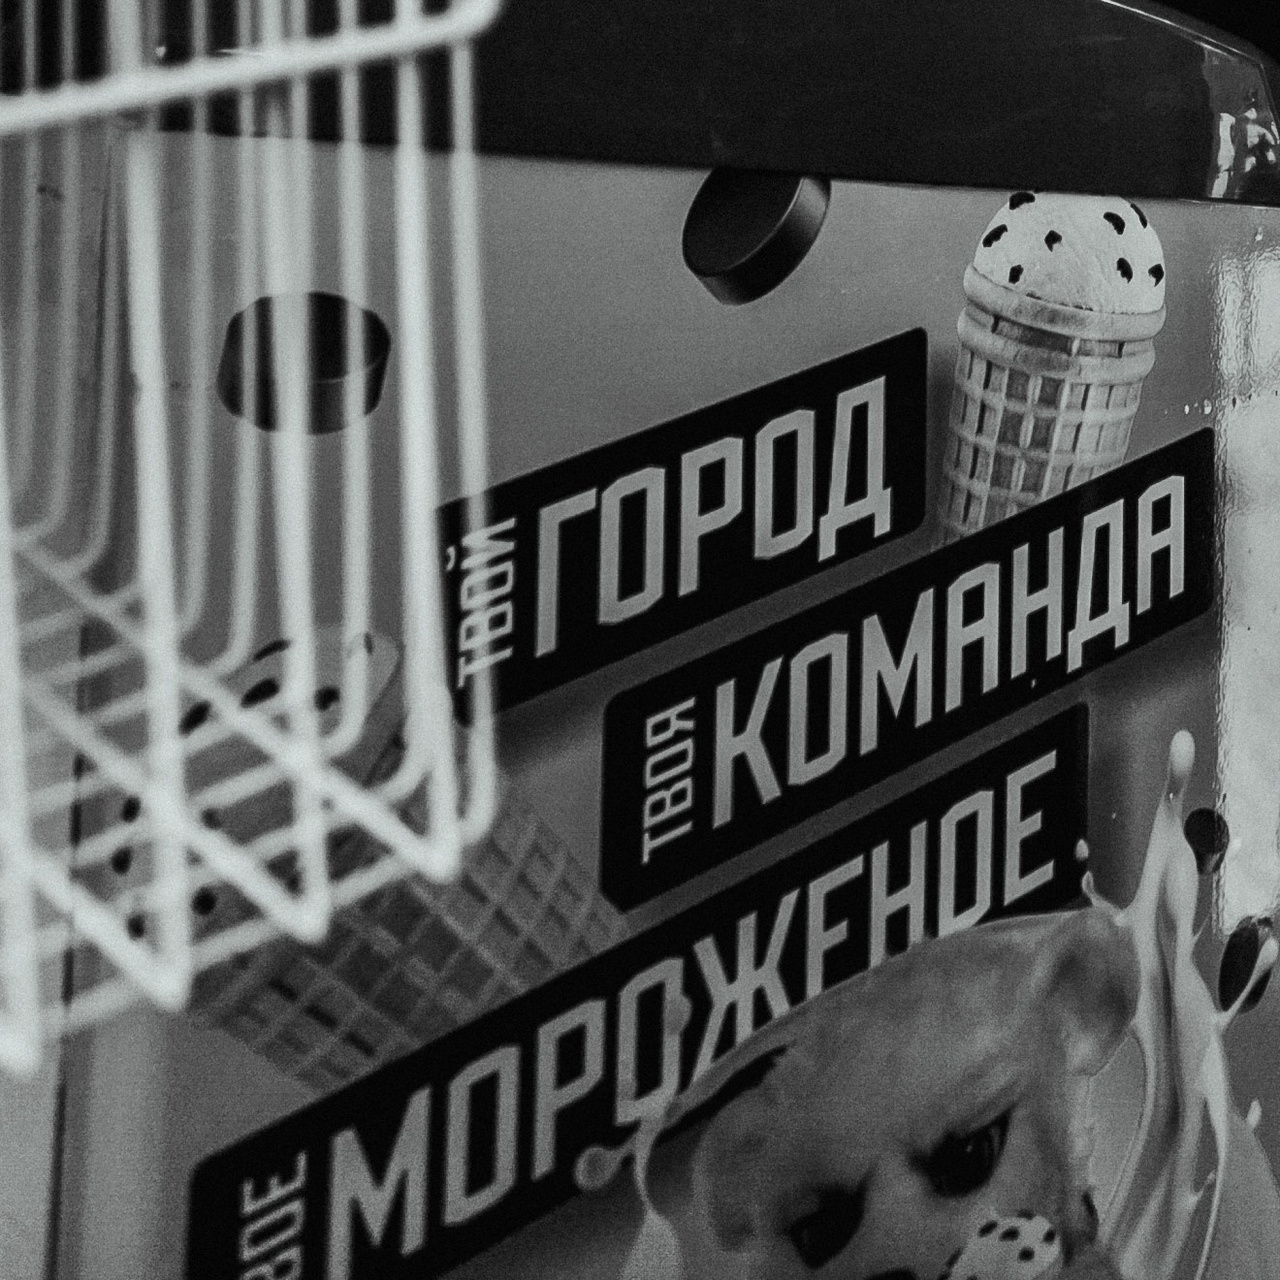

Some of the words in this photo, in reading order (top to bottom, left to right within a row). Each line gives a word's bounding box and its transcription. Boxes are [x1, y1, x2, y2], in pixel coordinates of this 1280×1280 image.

[446, 516, 516, 688] ТВОЙ
[535, 375, 892, 658] ГОРОД
[641, 696, 697, 866] ТВОЯ
[711, 474, 1186, 831] КОМАНДА
[325, 749, 1059, 1280] МОРОЖЕНОЕ
